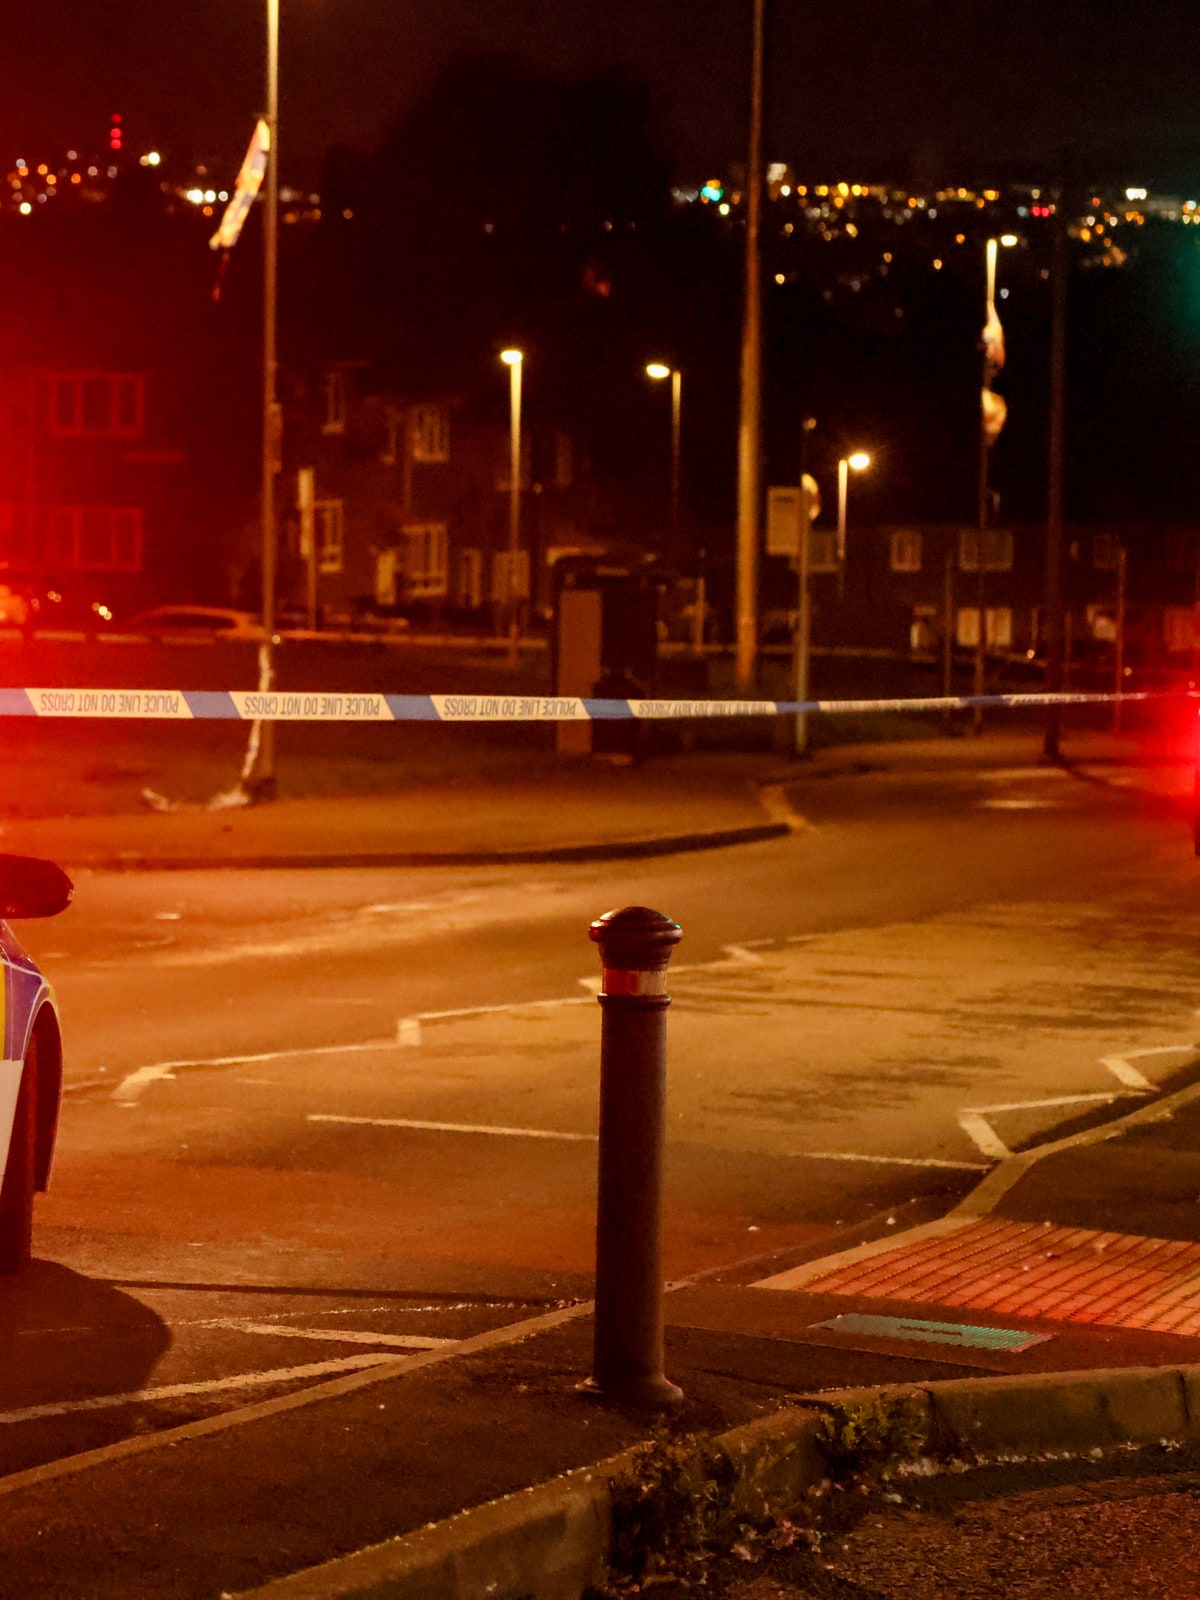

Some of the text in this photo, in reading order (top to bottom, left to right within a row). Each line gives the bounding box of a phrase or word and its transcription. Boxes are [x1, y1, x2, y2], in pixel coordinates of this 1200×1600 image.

[41, 693, 179, 713] POLICE LINE DO NOT CROSS
[245, 696, 381, 716] POLICE LINE DO NOT CROSS
[444, 698, 577, 716] POLICE LINE DO NOT CROSS
